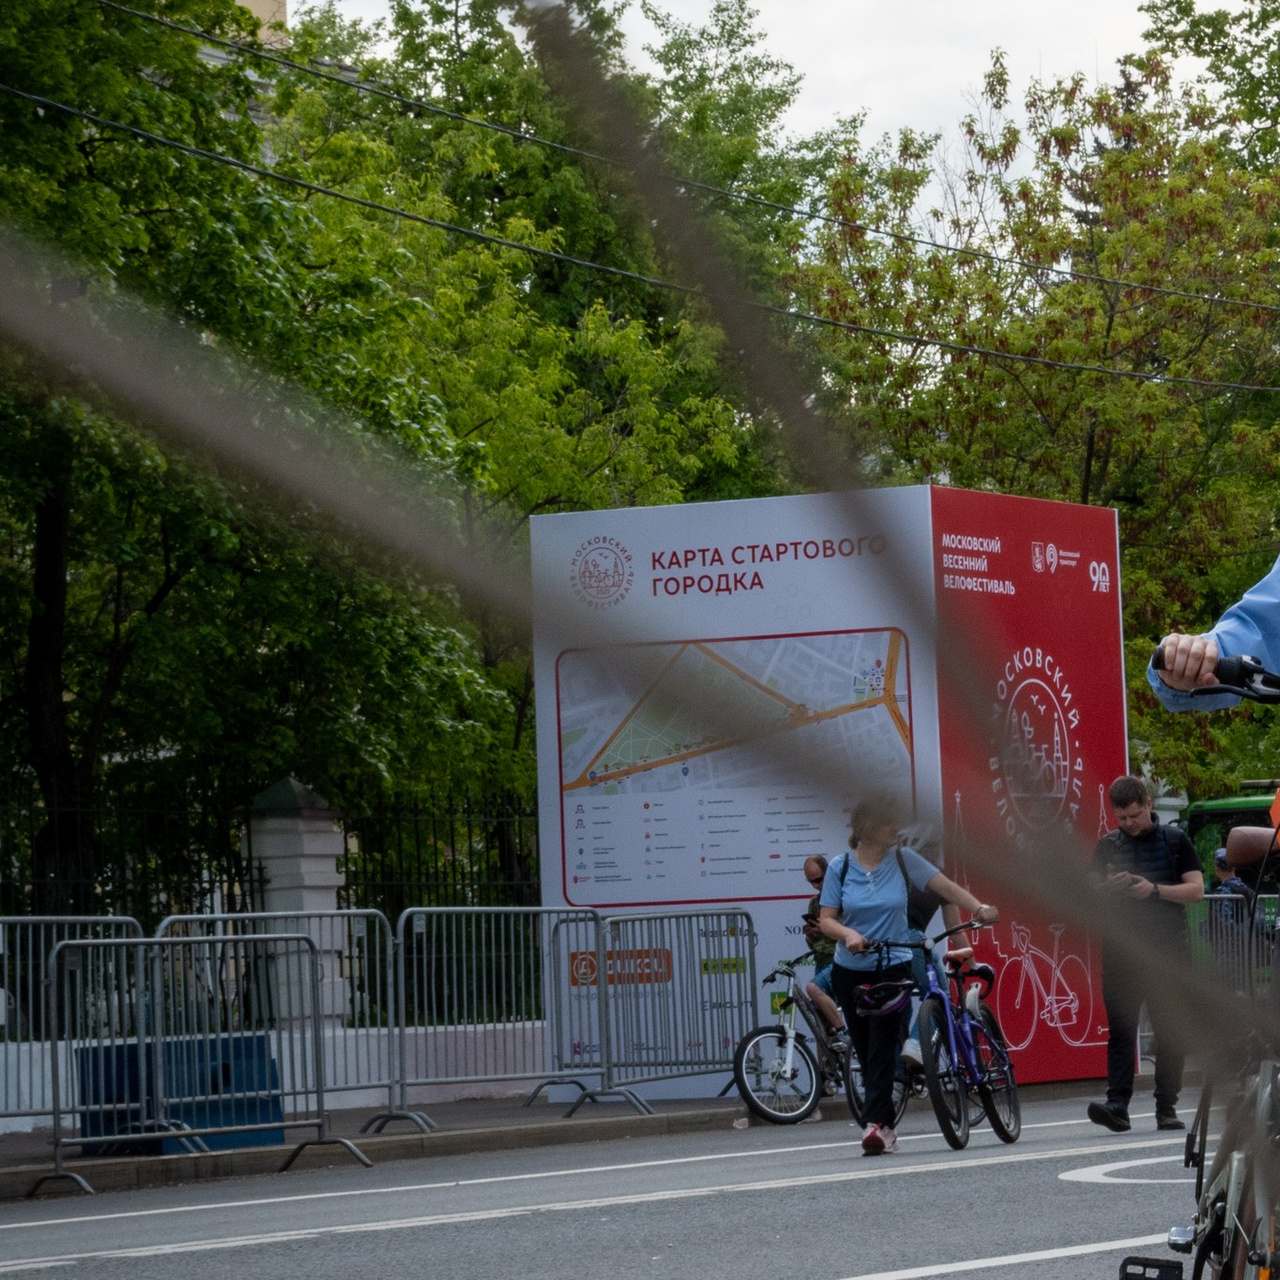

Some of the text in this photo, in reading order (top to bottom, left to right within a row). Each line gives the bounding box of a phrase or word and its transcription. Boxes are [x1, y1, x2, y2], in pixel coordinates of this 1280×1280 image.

[652, 534, 887, 570] КАРТА СТАРТОВОГО
[942, 533, 1001, 554] МОСКОВСКИЙ
[943, 554, 988, 572] ВЕСЕННИЙ
[653, 571, 765, 597] ГОРОДКА
[944, 575, 1016, 595] ВЕЛОФЕСТИВАЛЬ
